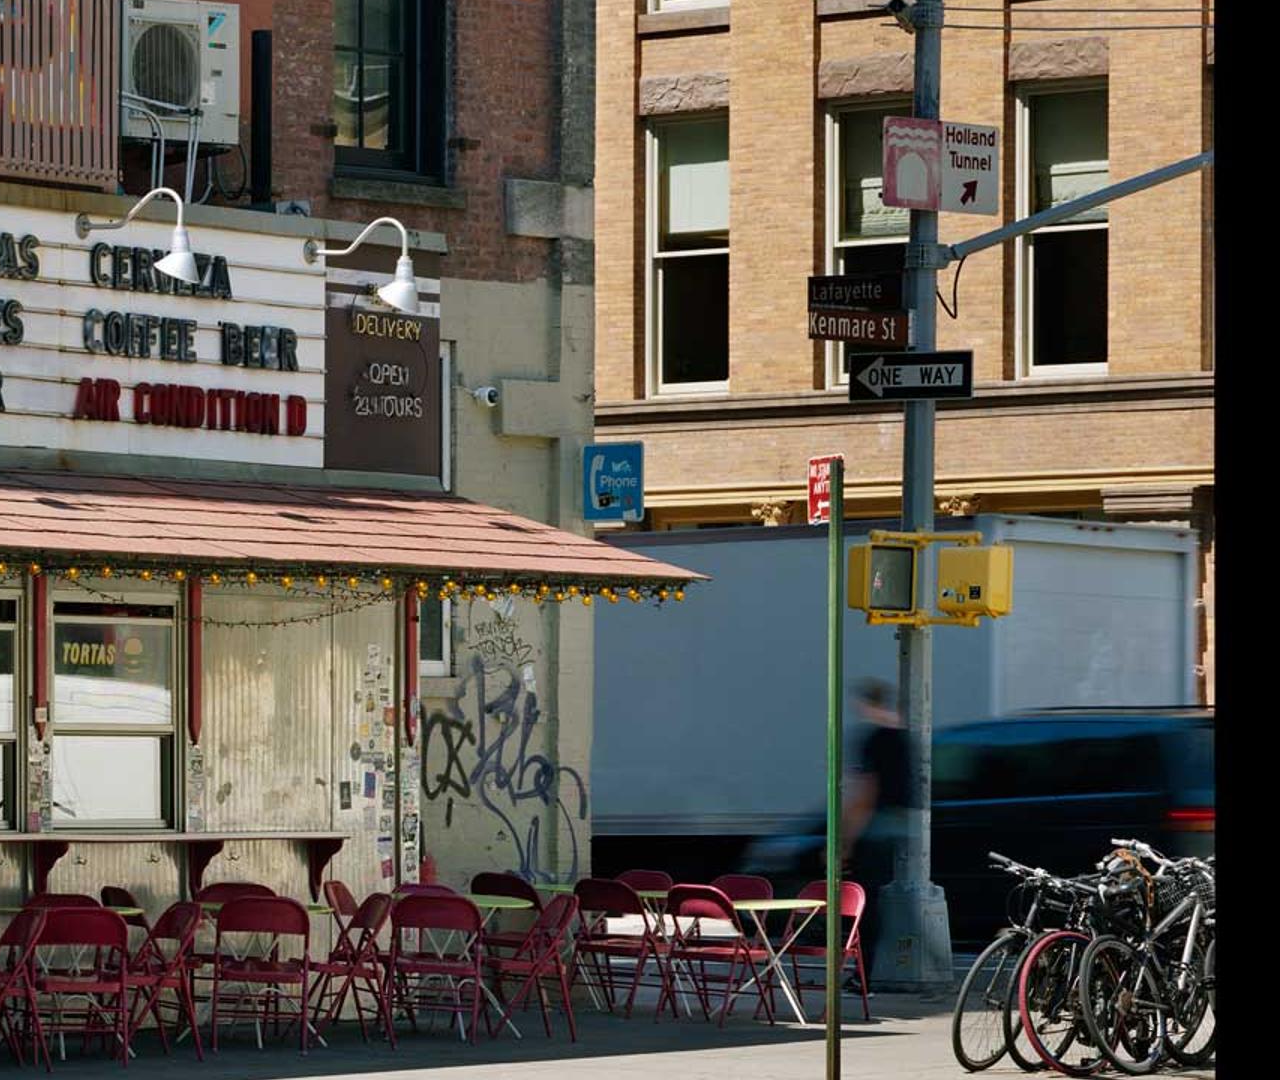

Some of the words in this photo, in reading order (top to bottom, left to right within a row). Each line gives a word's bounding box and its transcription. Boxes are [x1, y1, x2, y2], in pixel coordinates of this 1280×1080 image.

[945, 125, 997, 148] Holland
[948, 150, 992, 172] Tunnel
[812, 282, 883, 303] Lafayette
[354, 313, 422, 341] DELIVERY
[809, 311, 876, 339] Kenmare
[882, 317, 897, 341] St
[83, 306, 199, 364] COFFEE
[221, 320, 300, 373] BEER
[369, 363, 409, 386] OPEN
[868, 367, 902, 387] ONE
[918, 366, 957, 386] WAY
[76, 376, 122, 423] AIR
[601, 475, 638, 489] Phone
[62, 641, 116, 666] TORTAS
